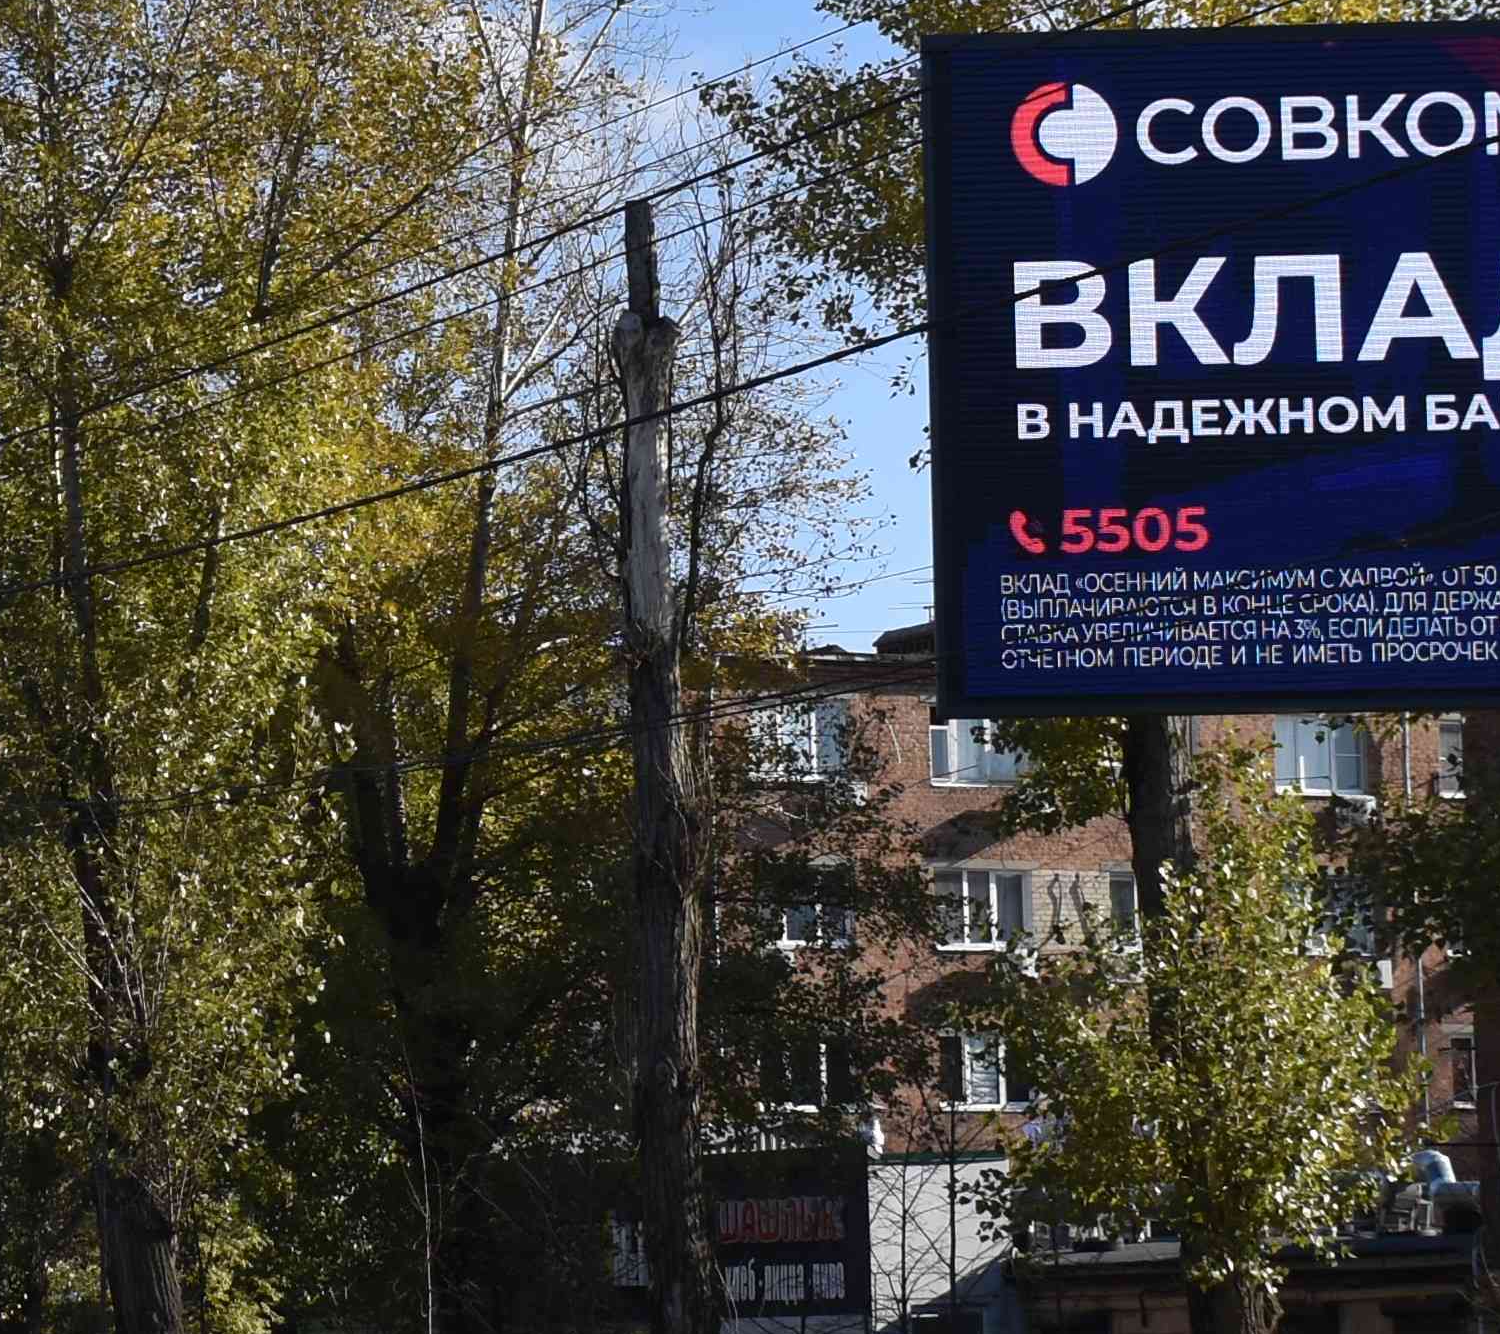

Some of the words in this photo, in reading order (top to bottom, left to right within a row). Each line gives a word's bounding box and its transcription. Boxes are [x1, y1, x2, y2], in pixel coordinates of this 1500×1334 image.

[1016, 403, 1051, 440] В
[1068, 395, 1407, 444] НАДЕЖНОМ
[1060, 507, 1211, 554] 5505
[1000, 573, 1071, 597] ВКЛАД
[1075, 567, 1187, 593] «ОСЕННИЙ
[1194, 569, 1315, 592] МАКСИМУМ
[1320, 569, 1335, 589] С
[1442, 565, 1470, 587] ОТ
[1474, 565, 1497, 586] 50
[1203, 596, 1218, 615] В
[1222, 594, 1294, 617] КОНЦЕ
[1383, 591, 1427, 615] ДЛЯ
[1001, 624, 1079, 645] СТАВКА
[1081, 620, 1256, 644] УВЕЛИЧИВАЕТСЯ
[1261, 620, 1291, 641] НА
[1293, 619, 1325, 643] 3%,
[1328, 617, 1382, 640] ЕСЛИ
[1386, 616, 1467, 641] ДЕЛАТЬ
[1471, 615, 1498, 637] ОТ
[1124, 645, 1223, 670] ПЕРИОДЕ
[1231, 645, 1247, 666] И
[1255, 644, 1284, 665] НЕ
[1292, 642, 1362, 664] ИМЕТЬ
[1371, 641, 1498, 663] ПРОСРОЧЕК
